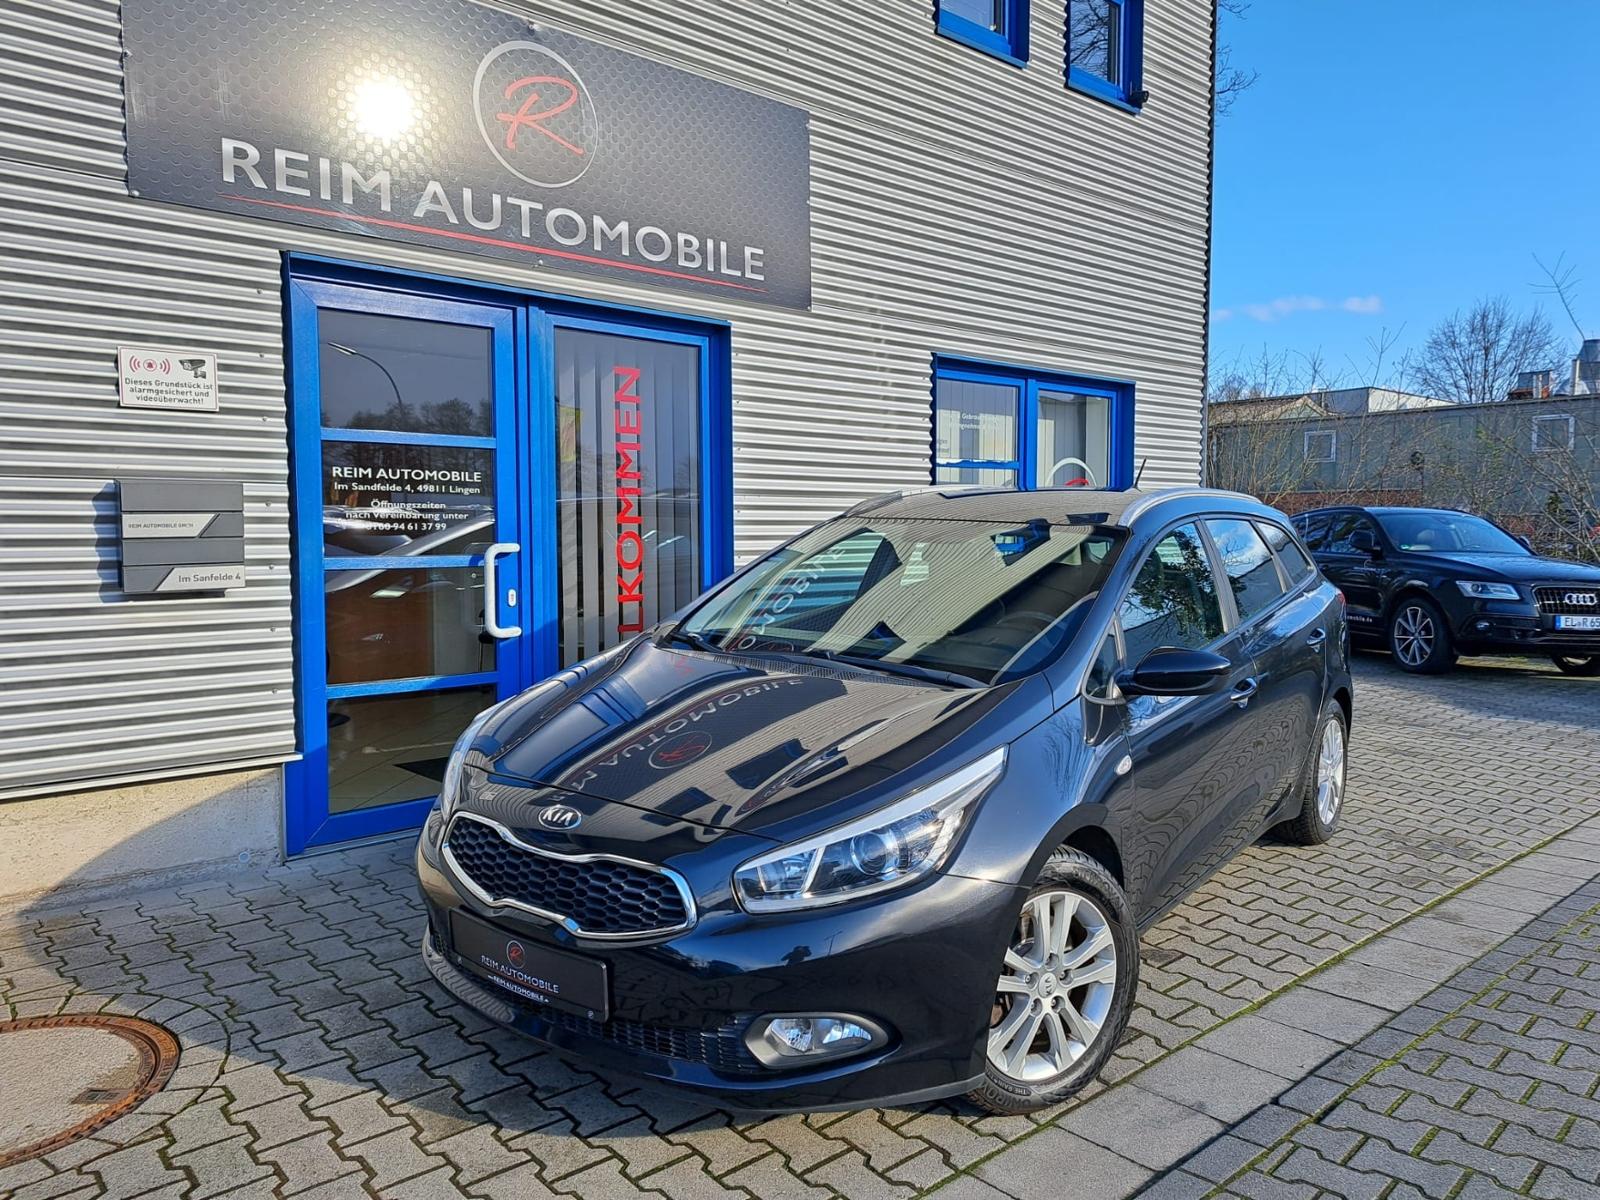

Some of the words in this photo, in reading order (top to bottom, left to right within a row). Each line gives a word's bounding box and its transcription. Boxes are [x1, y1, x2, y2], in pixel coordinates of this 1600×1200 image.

[495, 75, 585, 156] R
[221, 136, 392, 214] REIM
[412, 179, 766, 282] AUTOMOBILE
[125, 377, 153, 386] Dieses
[155, 379, 200, 390] Grundstück
[203, 382, 213, 390] ist
[129, 386, 193, 397] alarmgesichert
[136, 394, 204, 405] videoüberwacht!
[332, 466, 372, 479] REIM
[376, 468, 482, 483] AUTOMOBILE
[334, 482, 348, 491] Im
[351, 482, 402, 492] Sandfelde
[404, 484, 414, 493] 4,
[416, 484, 446, 493] 49811
[449, 485, 481, 495] Lingen
[370, 498, 446, 511] Öffnungszeiten
[612, 366, 644, 633] LKOMMEN
[345, 511, 370, 519] nach
[372, 510, 440, 521] Vereinbarung
[442, 512, 469, 520] unter
[407, 522, 418, 531] 61
[421, 522, 433, 531] 37
[435, 522, 447, 531] 99
[178, 575, 191, 583] Im
[193, 573, 233, 582] Sanfelde
[542, 808, 574, 826] KIA
[481, 955, 499, 970] REIM
[500, 965, 560, 994] AUTOMOBILE
